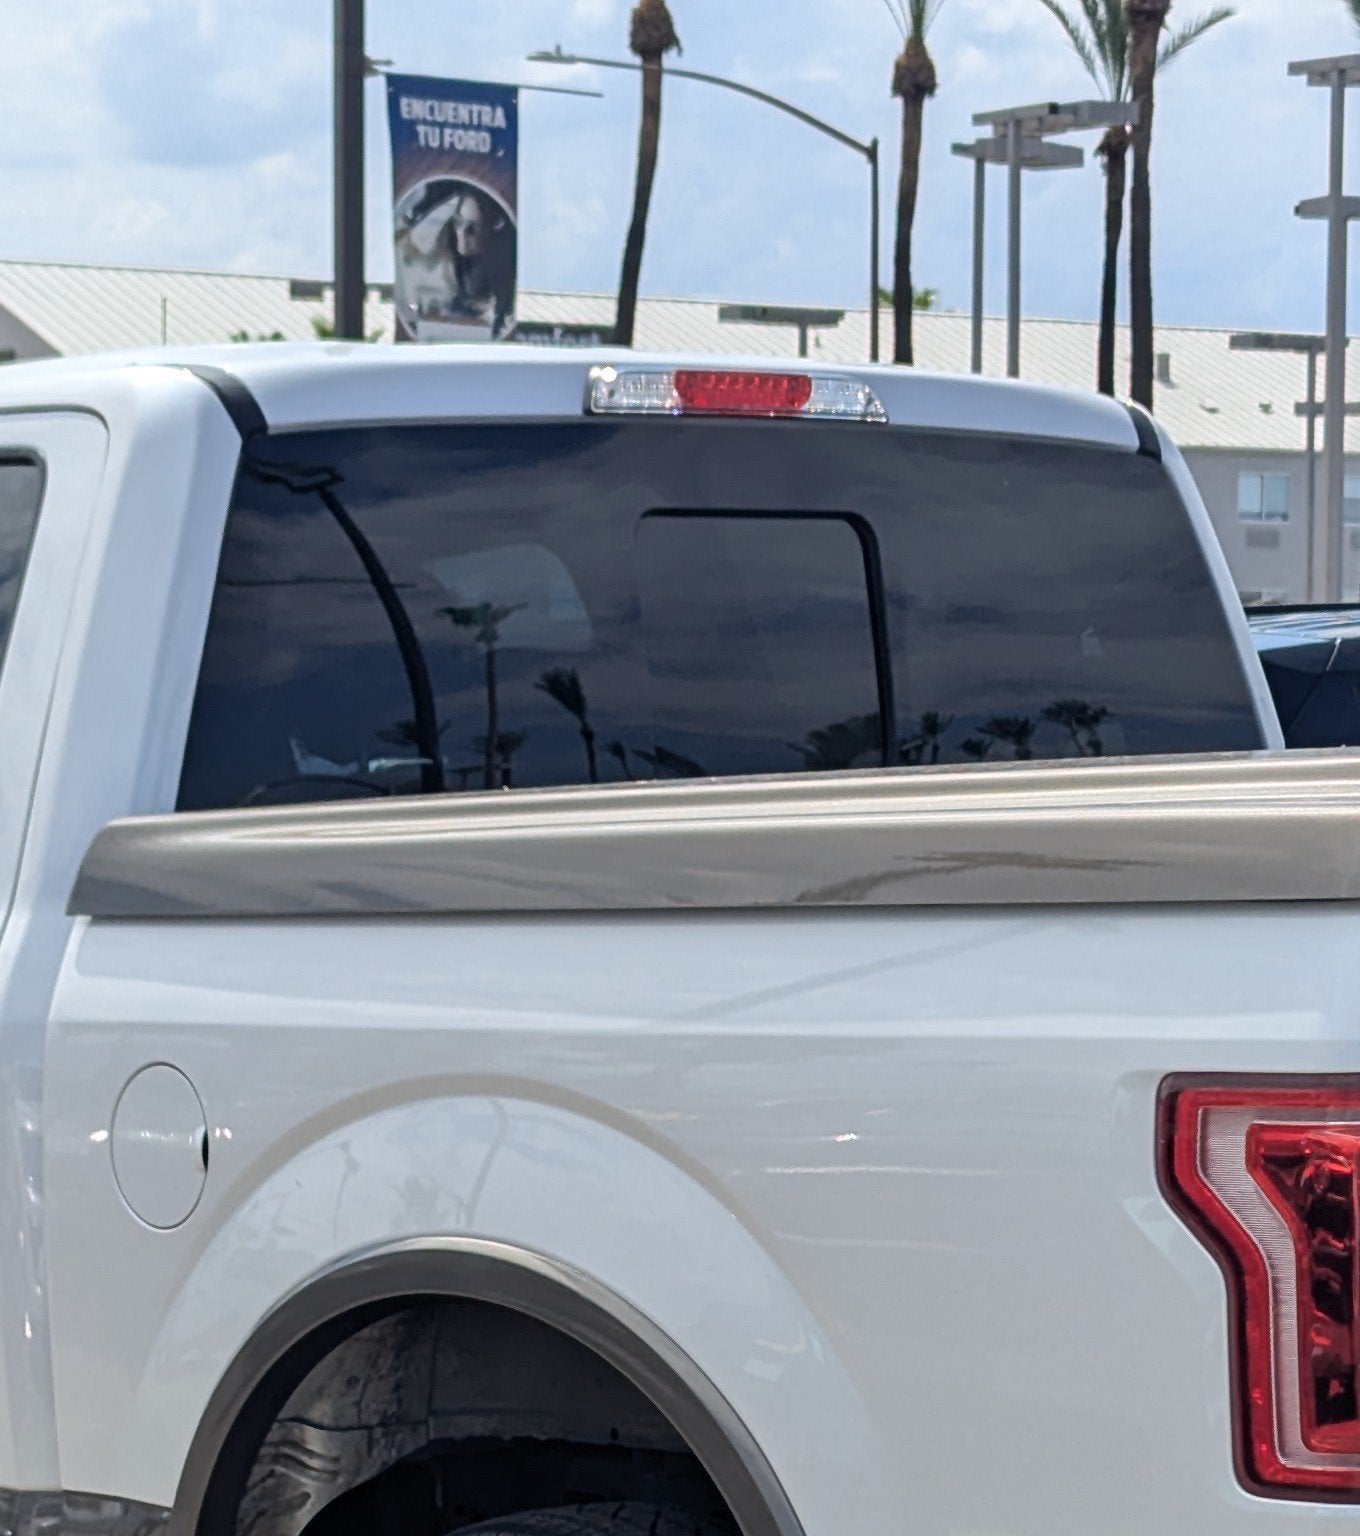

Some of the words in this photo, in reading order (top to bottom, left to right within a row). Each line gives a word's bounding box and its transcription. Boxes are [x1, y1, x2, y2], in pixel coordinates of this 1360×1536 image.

[400, 97, 506, 129] ENCUENTRA
[416, 125, 440, 148] TU
[443, 128, 491, 155] FORD
